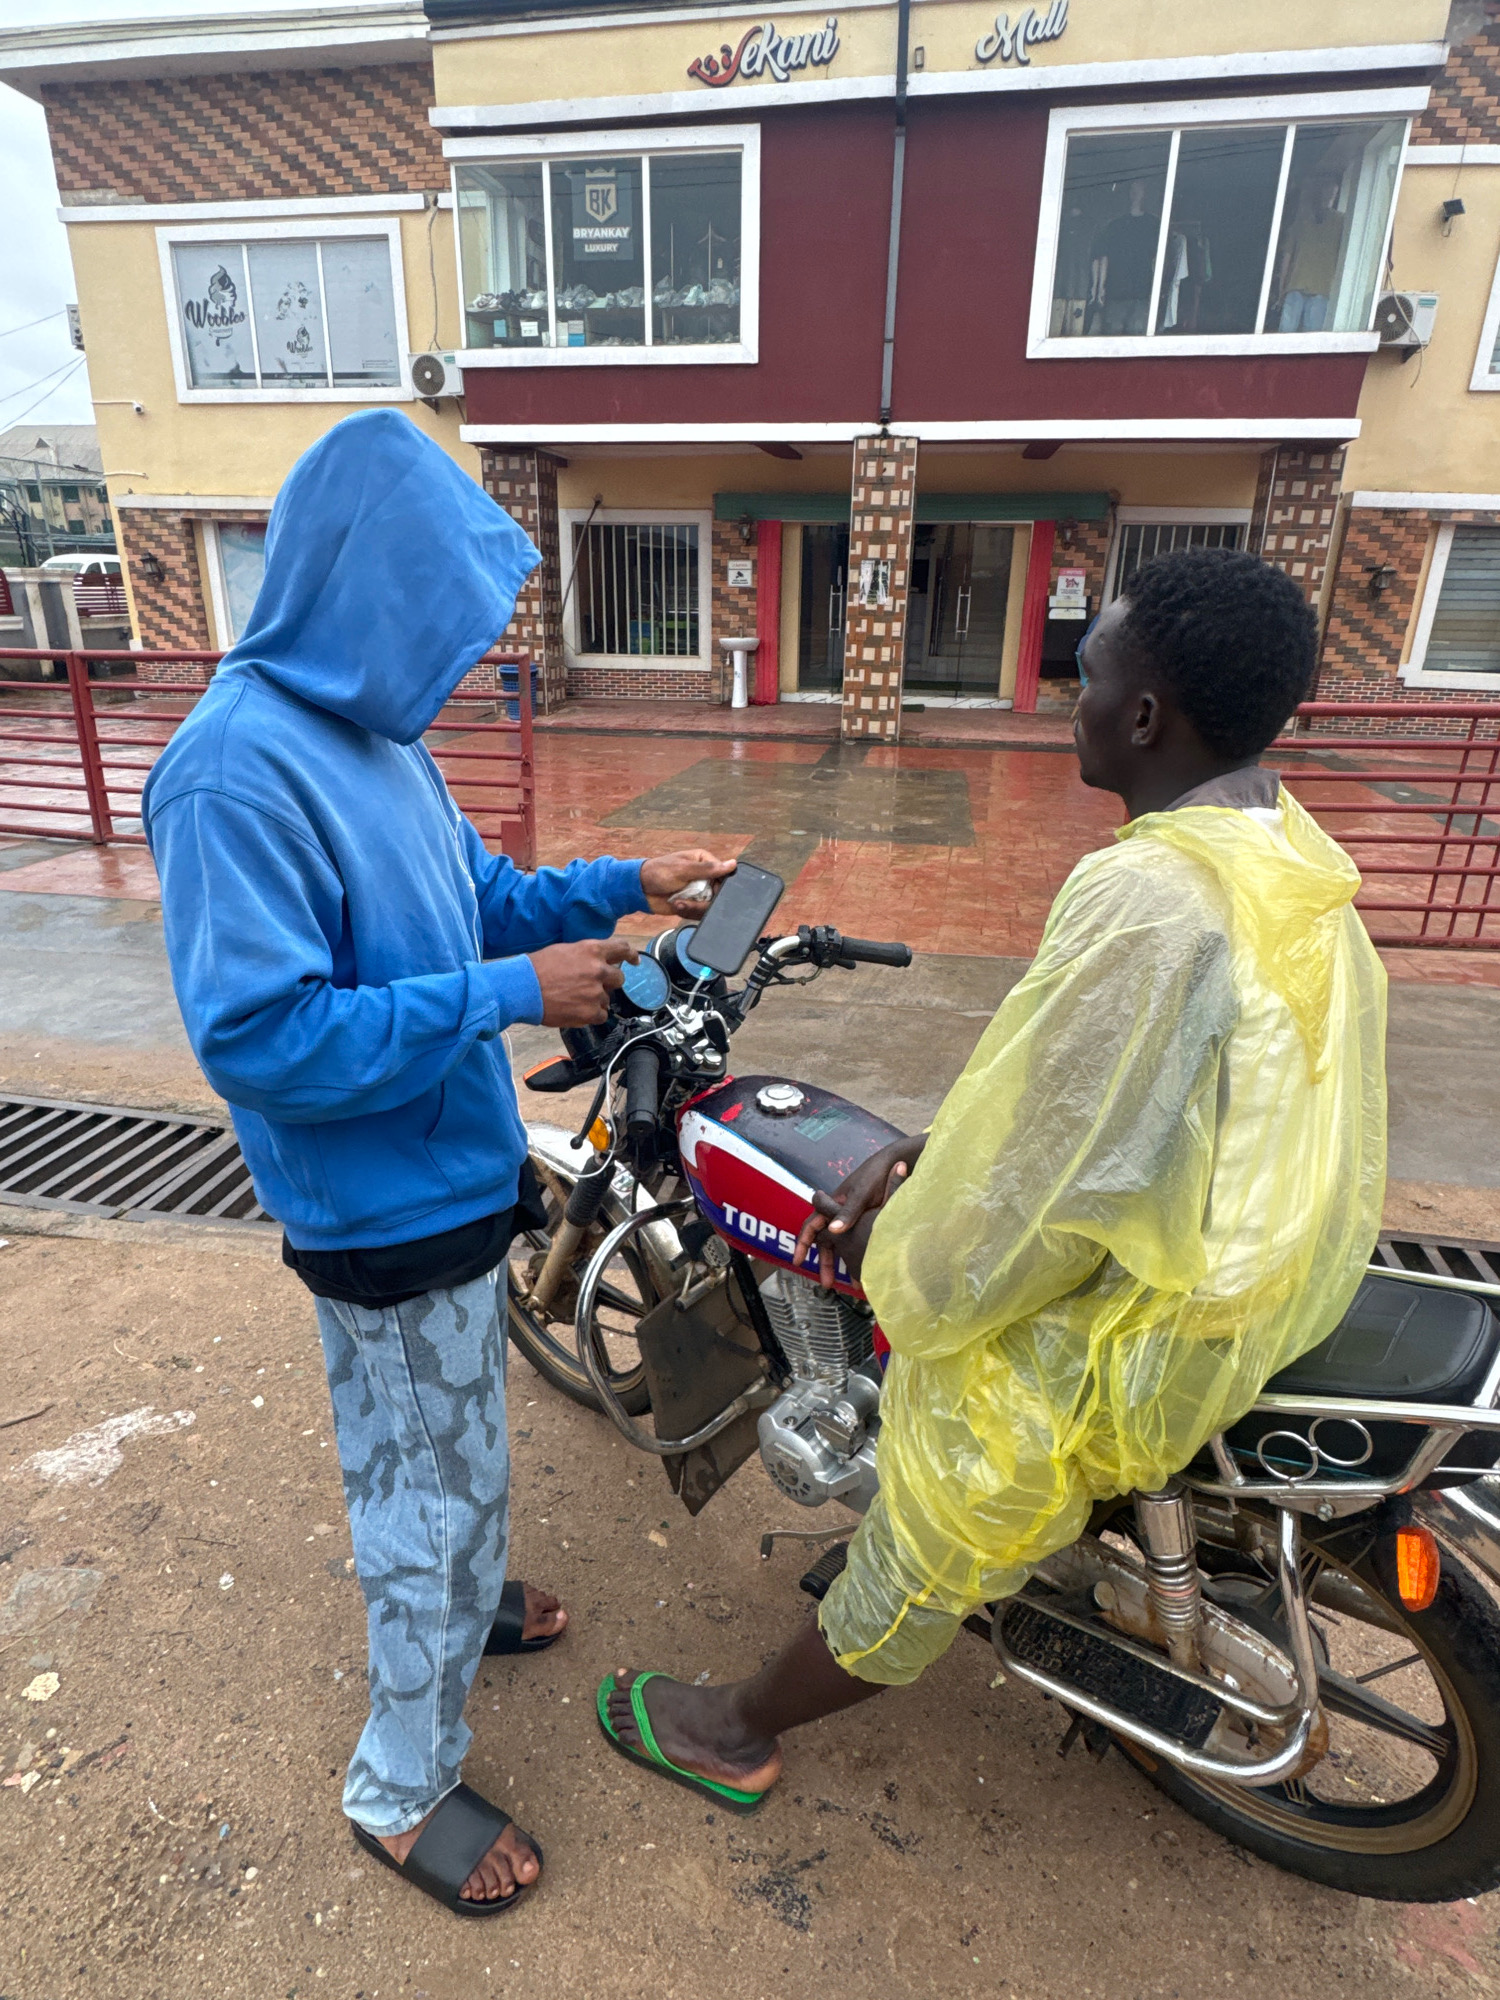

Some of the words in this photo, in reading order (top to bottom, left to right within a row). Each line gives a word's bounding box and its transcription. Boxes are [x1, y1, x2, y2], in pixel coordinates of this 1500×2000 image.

[974, 0, 1069, 65] Mall
[589, 188, 612, 217] BK
[572, 227, 631, 239] BRYANKAY
[584, 242, 619, 253] LUXURY
[185, 297, 246, 329] Woobles
